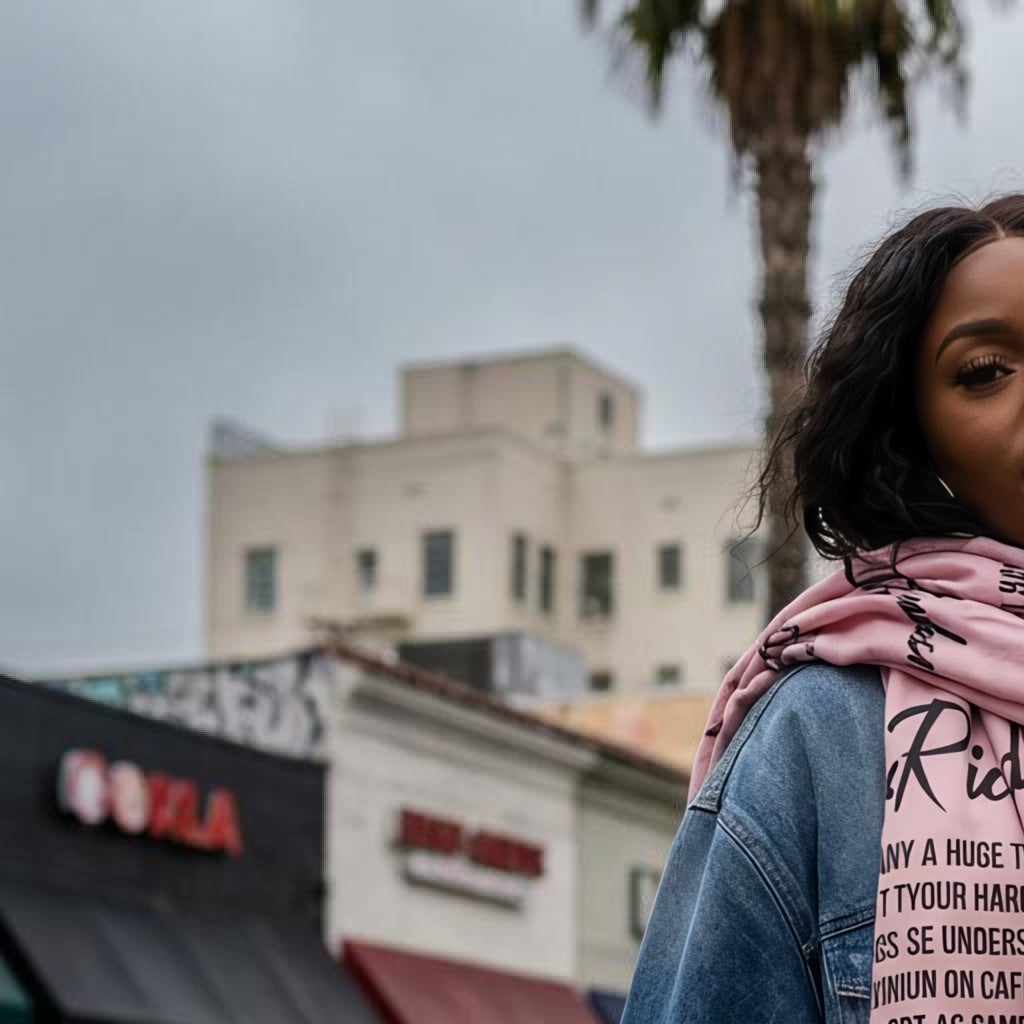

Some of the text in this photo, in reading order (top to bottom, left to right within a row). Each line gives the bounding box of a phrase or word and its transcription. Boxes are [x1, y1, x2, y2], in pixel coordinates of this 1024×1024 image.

[921, 838, 938, 866] A
[946, 838, 1004, 869] HUGE
[907, 926, 935, 956] SE
[944, 969, 974, 999] ON
